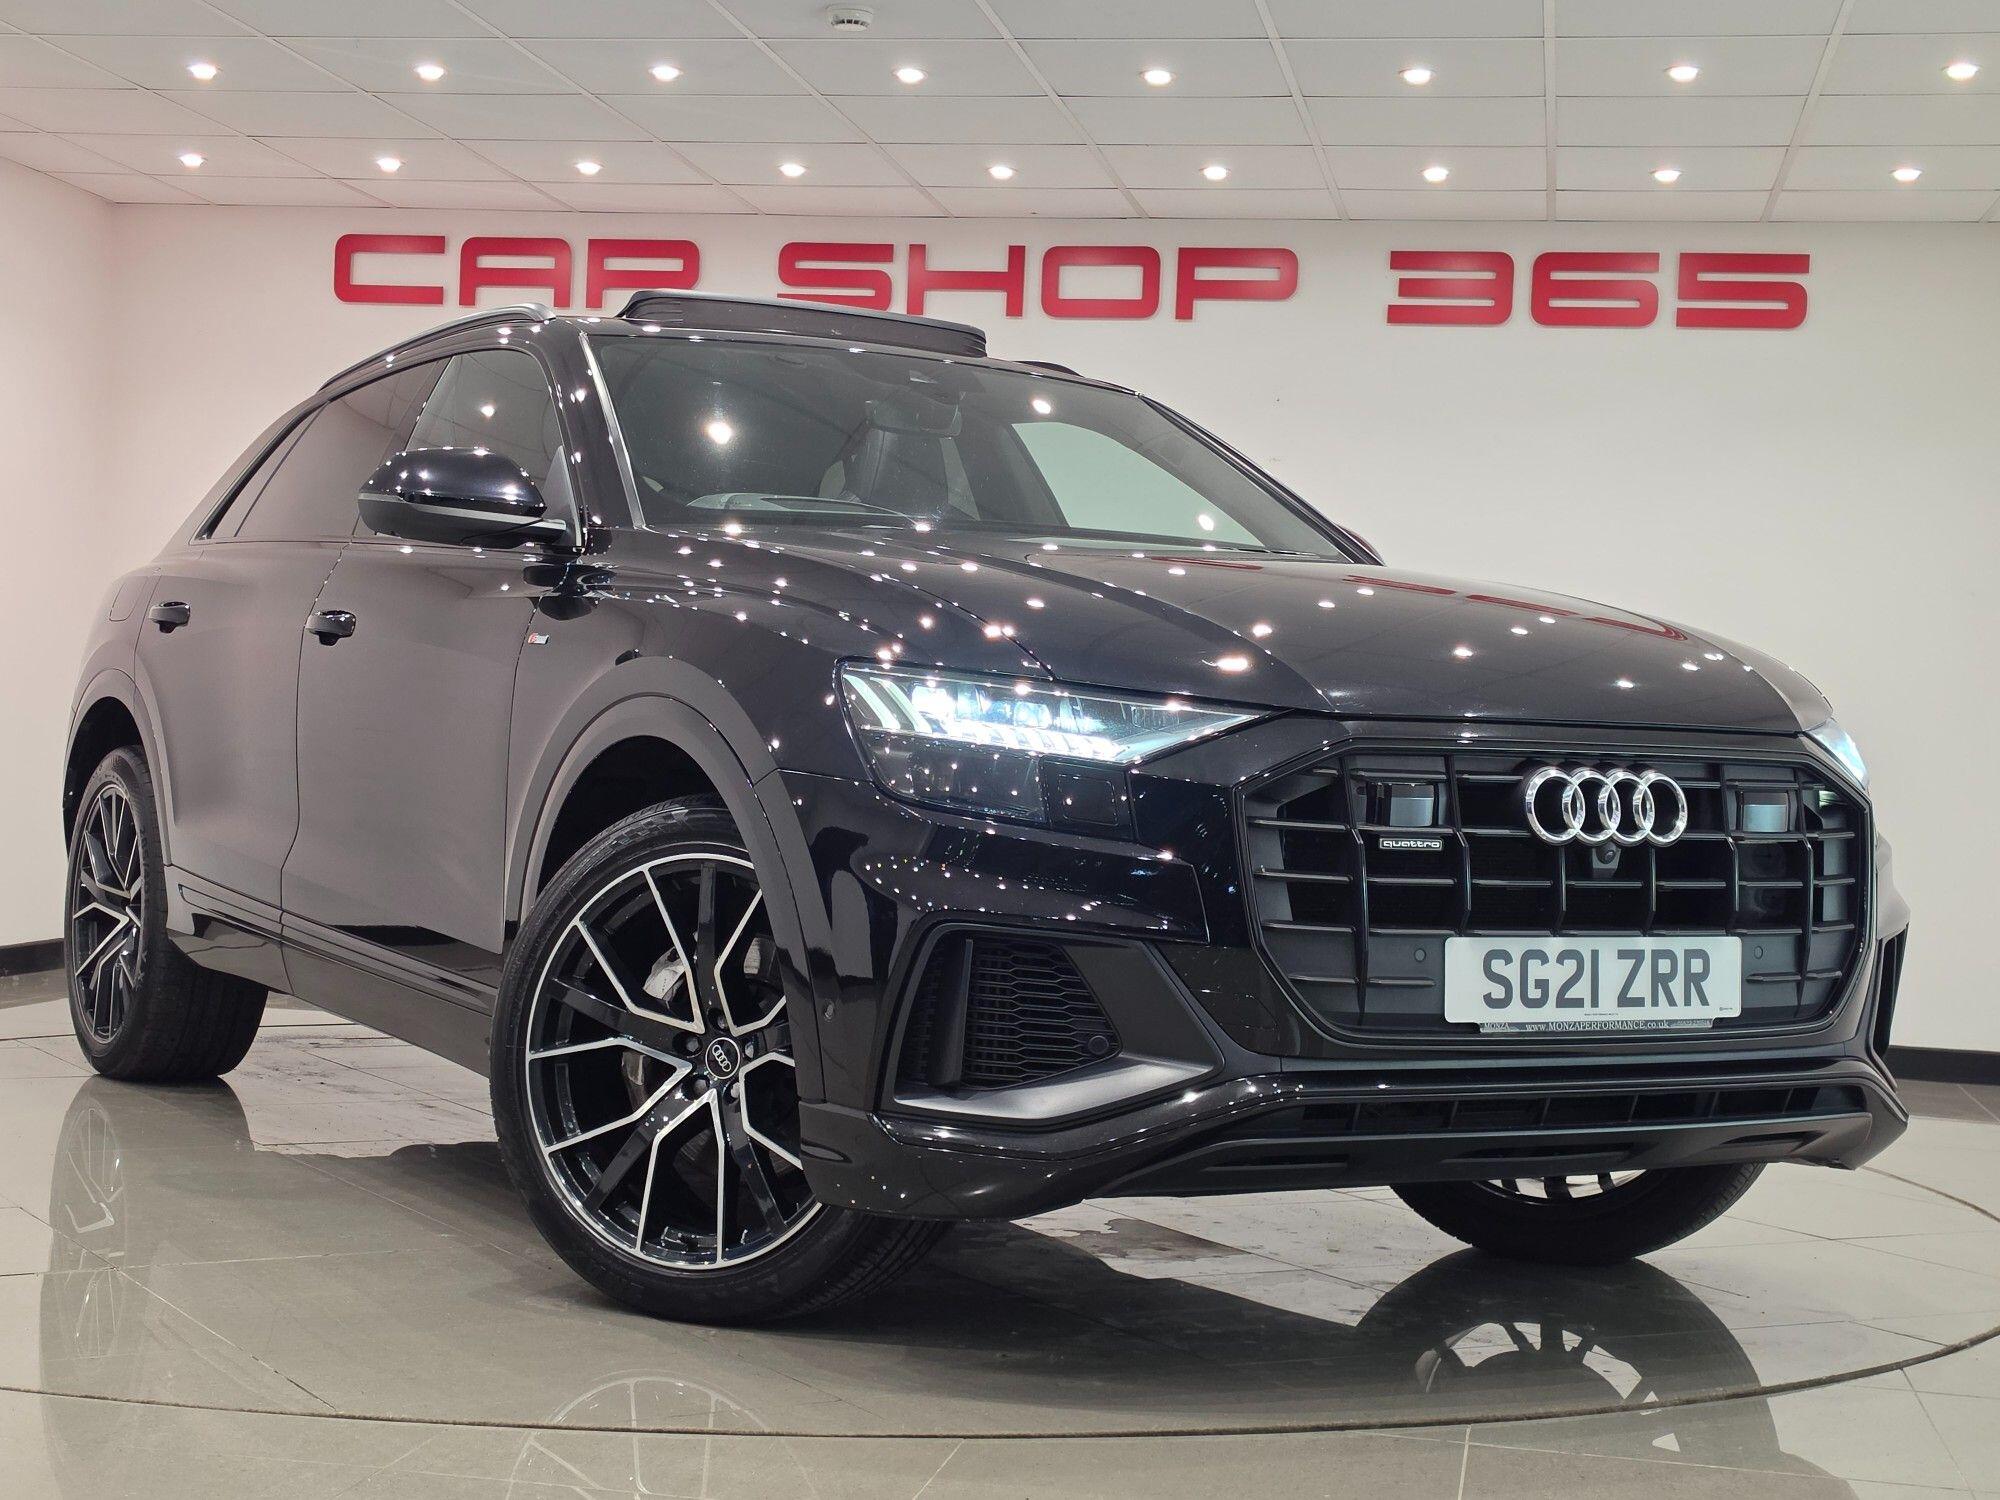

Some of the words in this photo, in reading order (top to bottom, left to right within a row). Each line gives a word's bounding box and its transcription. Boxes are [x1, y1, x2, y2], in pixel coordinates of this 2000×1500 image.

[334, 233, 700, 308] CAR
[777, 242, 1299, 320] SHOP
[1386, 250, 1811, 328] 365
[1383, 839, 1440, 848] quattro
[1482, 949, 1600, 1008] SG21
[1617, 949, 1711, 1008] ZRR
